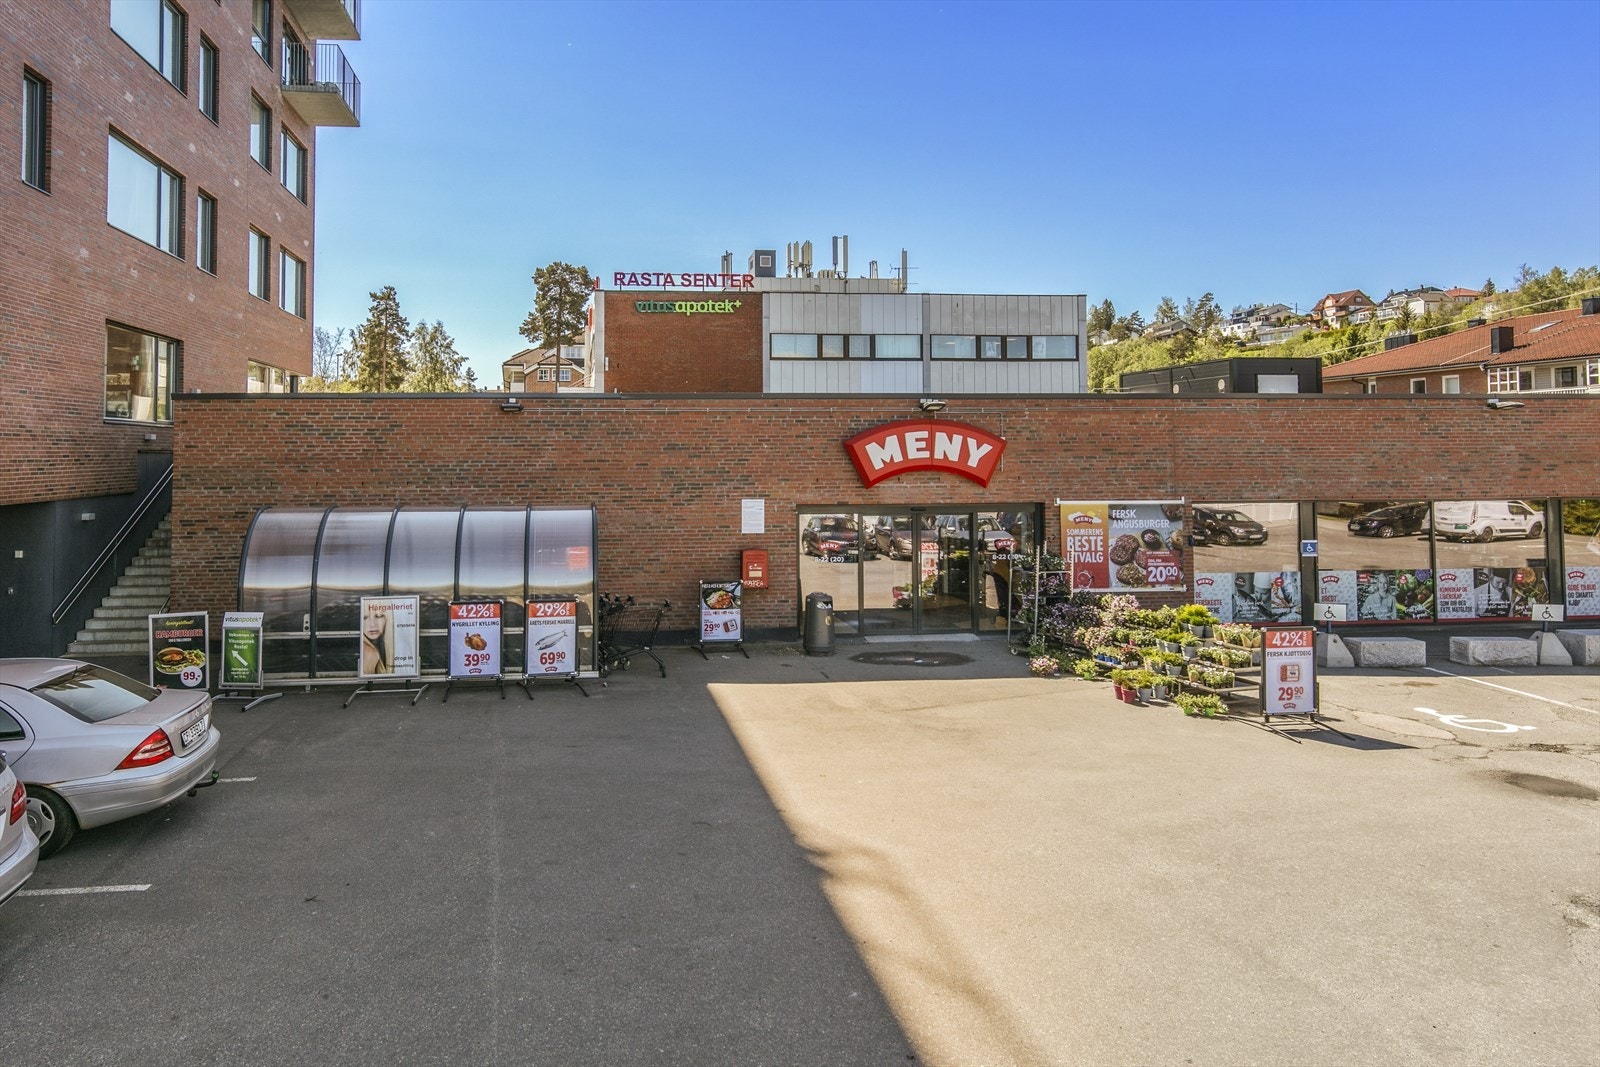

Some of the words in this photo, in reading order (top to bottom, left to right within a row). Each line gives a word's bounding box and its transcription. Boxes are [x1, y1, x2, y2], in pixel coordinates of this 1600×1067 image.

[614, 272, 675, 287] RASTA
[681, 273, 755, 288] SENTER
[864, 430, 994, 471] MENY
[1112, 509, 1137, 519] FERSK
[1112, 519, 1170, 529] ANGUSBURGER
[1066, 528, 1104, 536] SOMMERENS
[1066, 536, 1104, 551] BESTE
[368, 603, 413, 612] Hårgalleriet
[458, 604, 490, 618] 42%
[536, 602, 566, 616] 29%
[156, 629, 203, 638] HAMBURGER
[1272, 631, 1303, 647] 42%
[183, 671, 201, 681] 99,-
